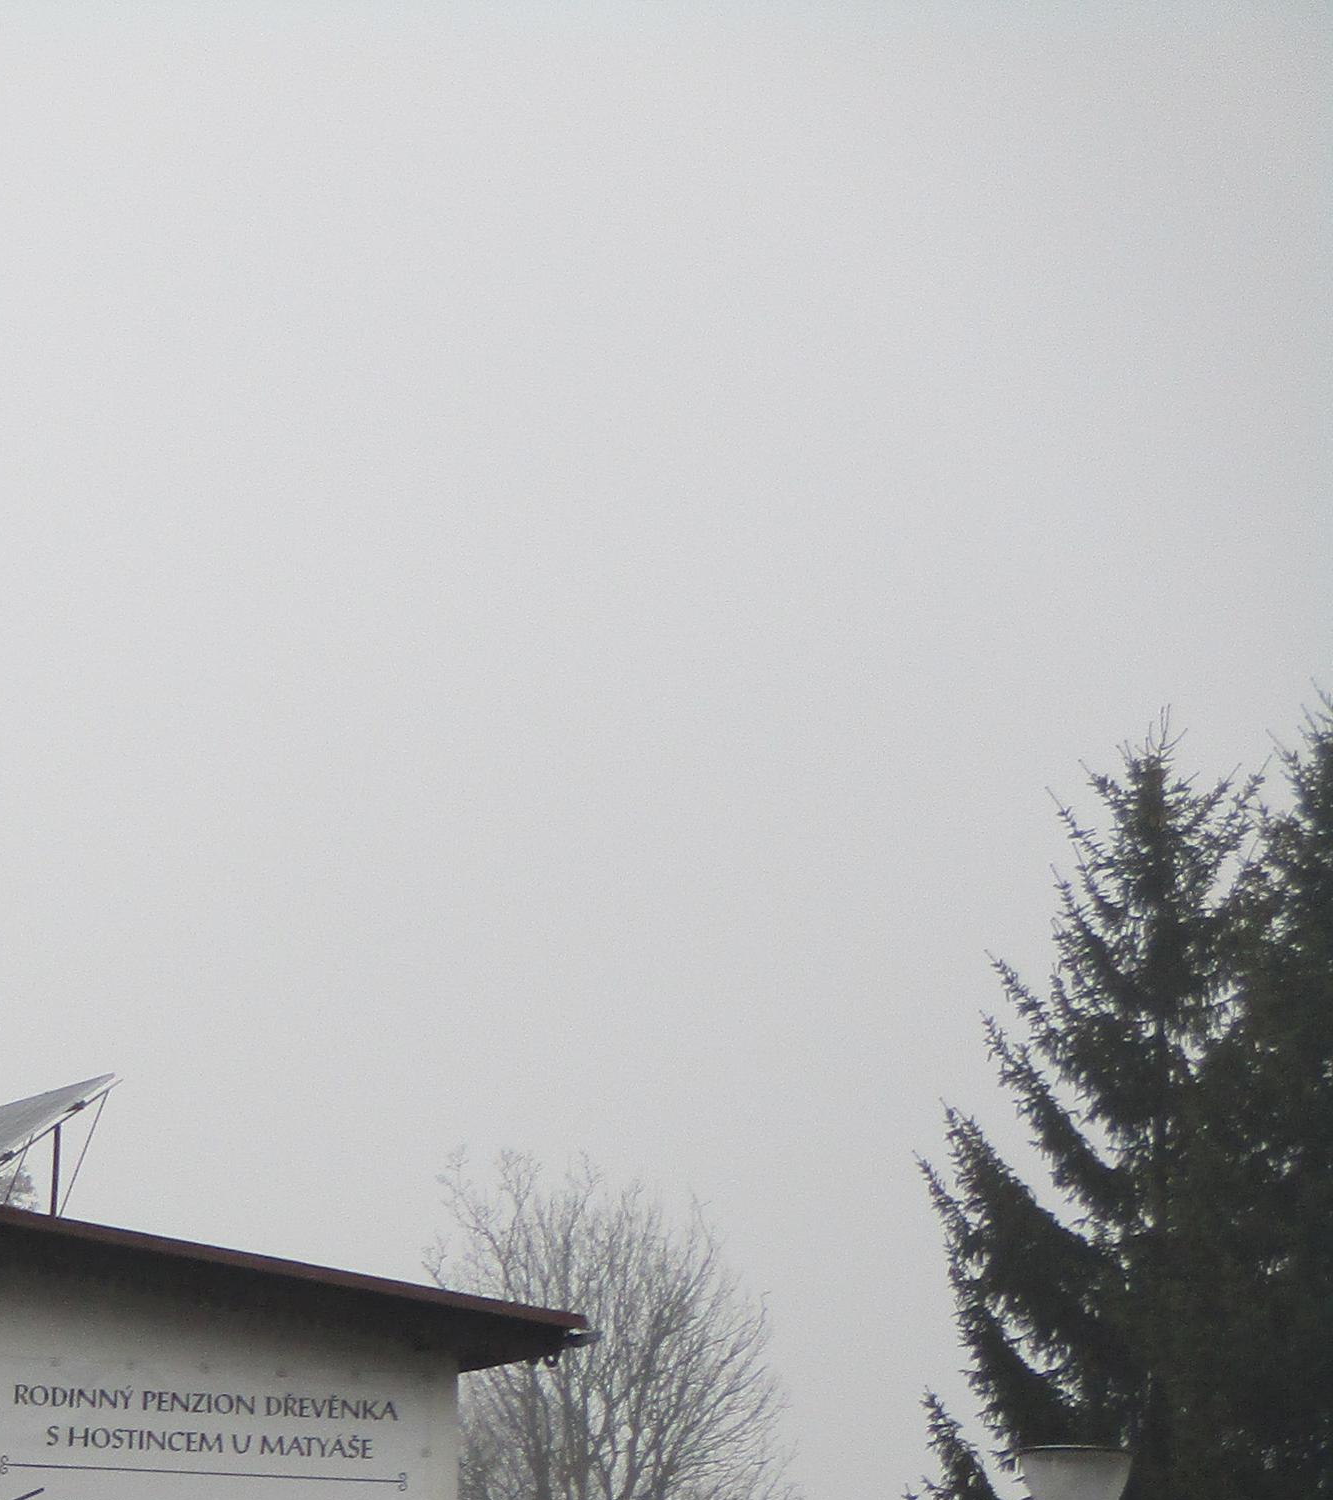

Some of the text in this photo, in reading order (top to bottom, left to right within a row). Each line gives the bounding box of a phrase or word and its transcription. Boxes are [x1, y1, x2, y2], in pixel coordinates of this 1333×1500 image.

[14, 1384, 399, 1421] RODINNÝ PENZION DŘEVĚNKA
[46, 1425, 374, 1459] S HOSTINCEM U MATYÁŠE
